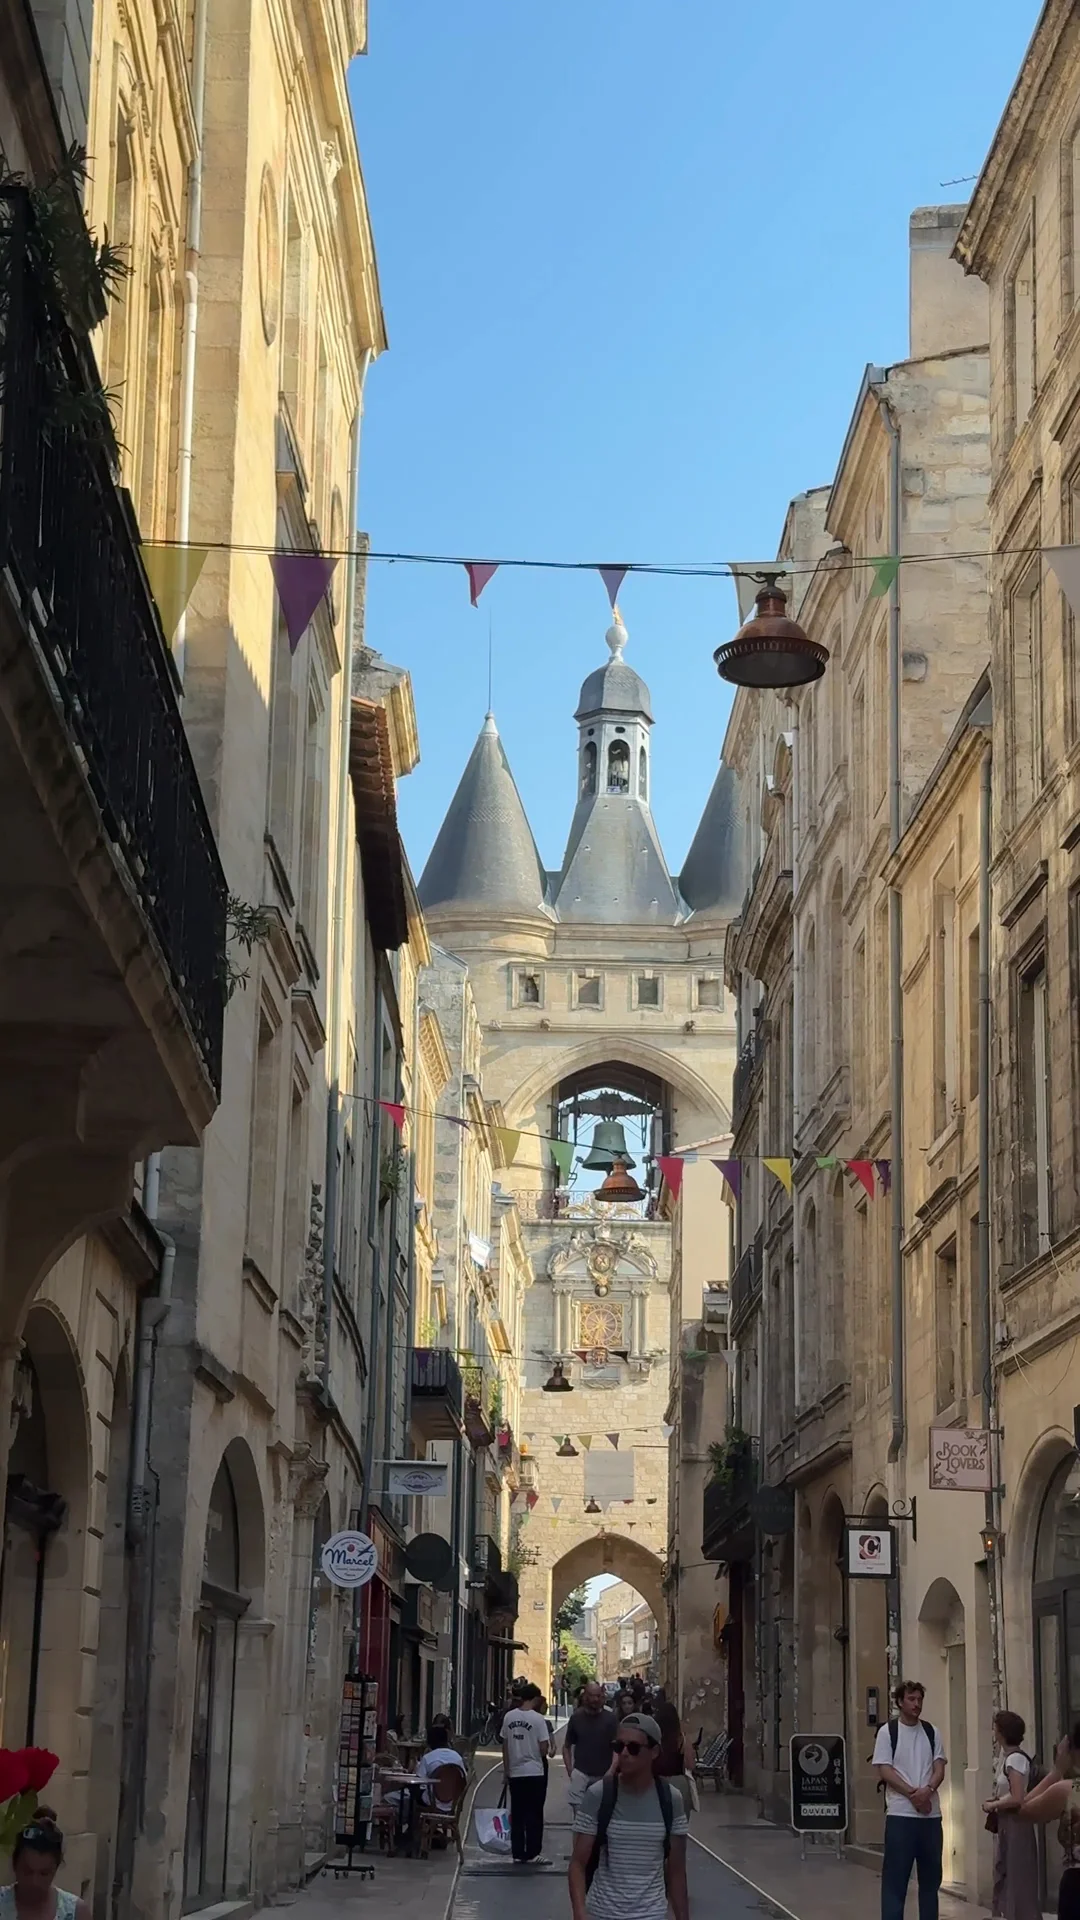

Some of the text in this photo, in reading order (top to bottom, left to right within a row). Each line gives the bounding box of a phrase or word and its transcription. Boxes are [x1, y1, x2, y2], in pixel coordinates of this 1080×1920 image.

[936, 1441, 977, 1460] BOOK
[946, 1457, 985, 1474] LOVERS
[325, 1548, 374, 1566] Marcel
[801, 1776, 828, 1785] JAPAN
